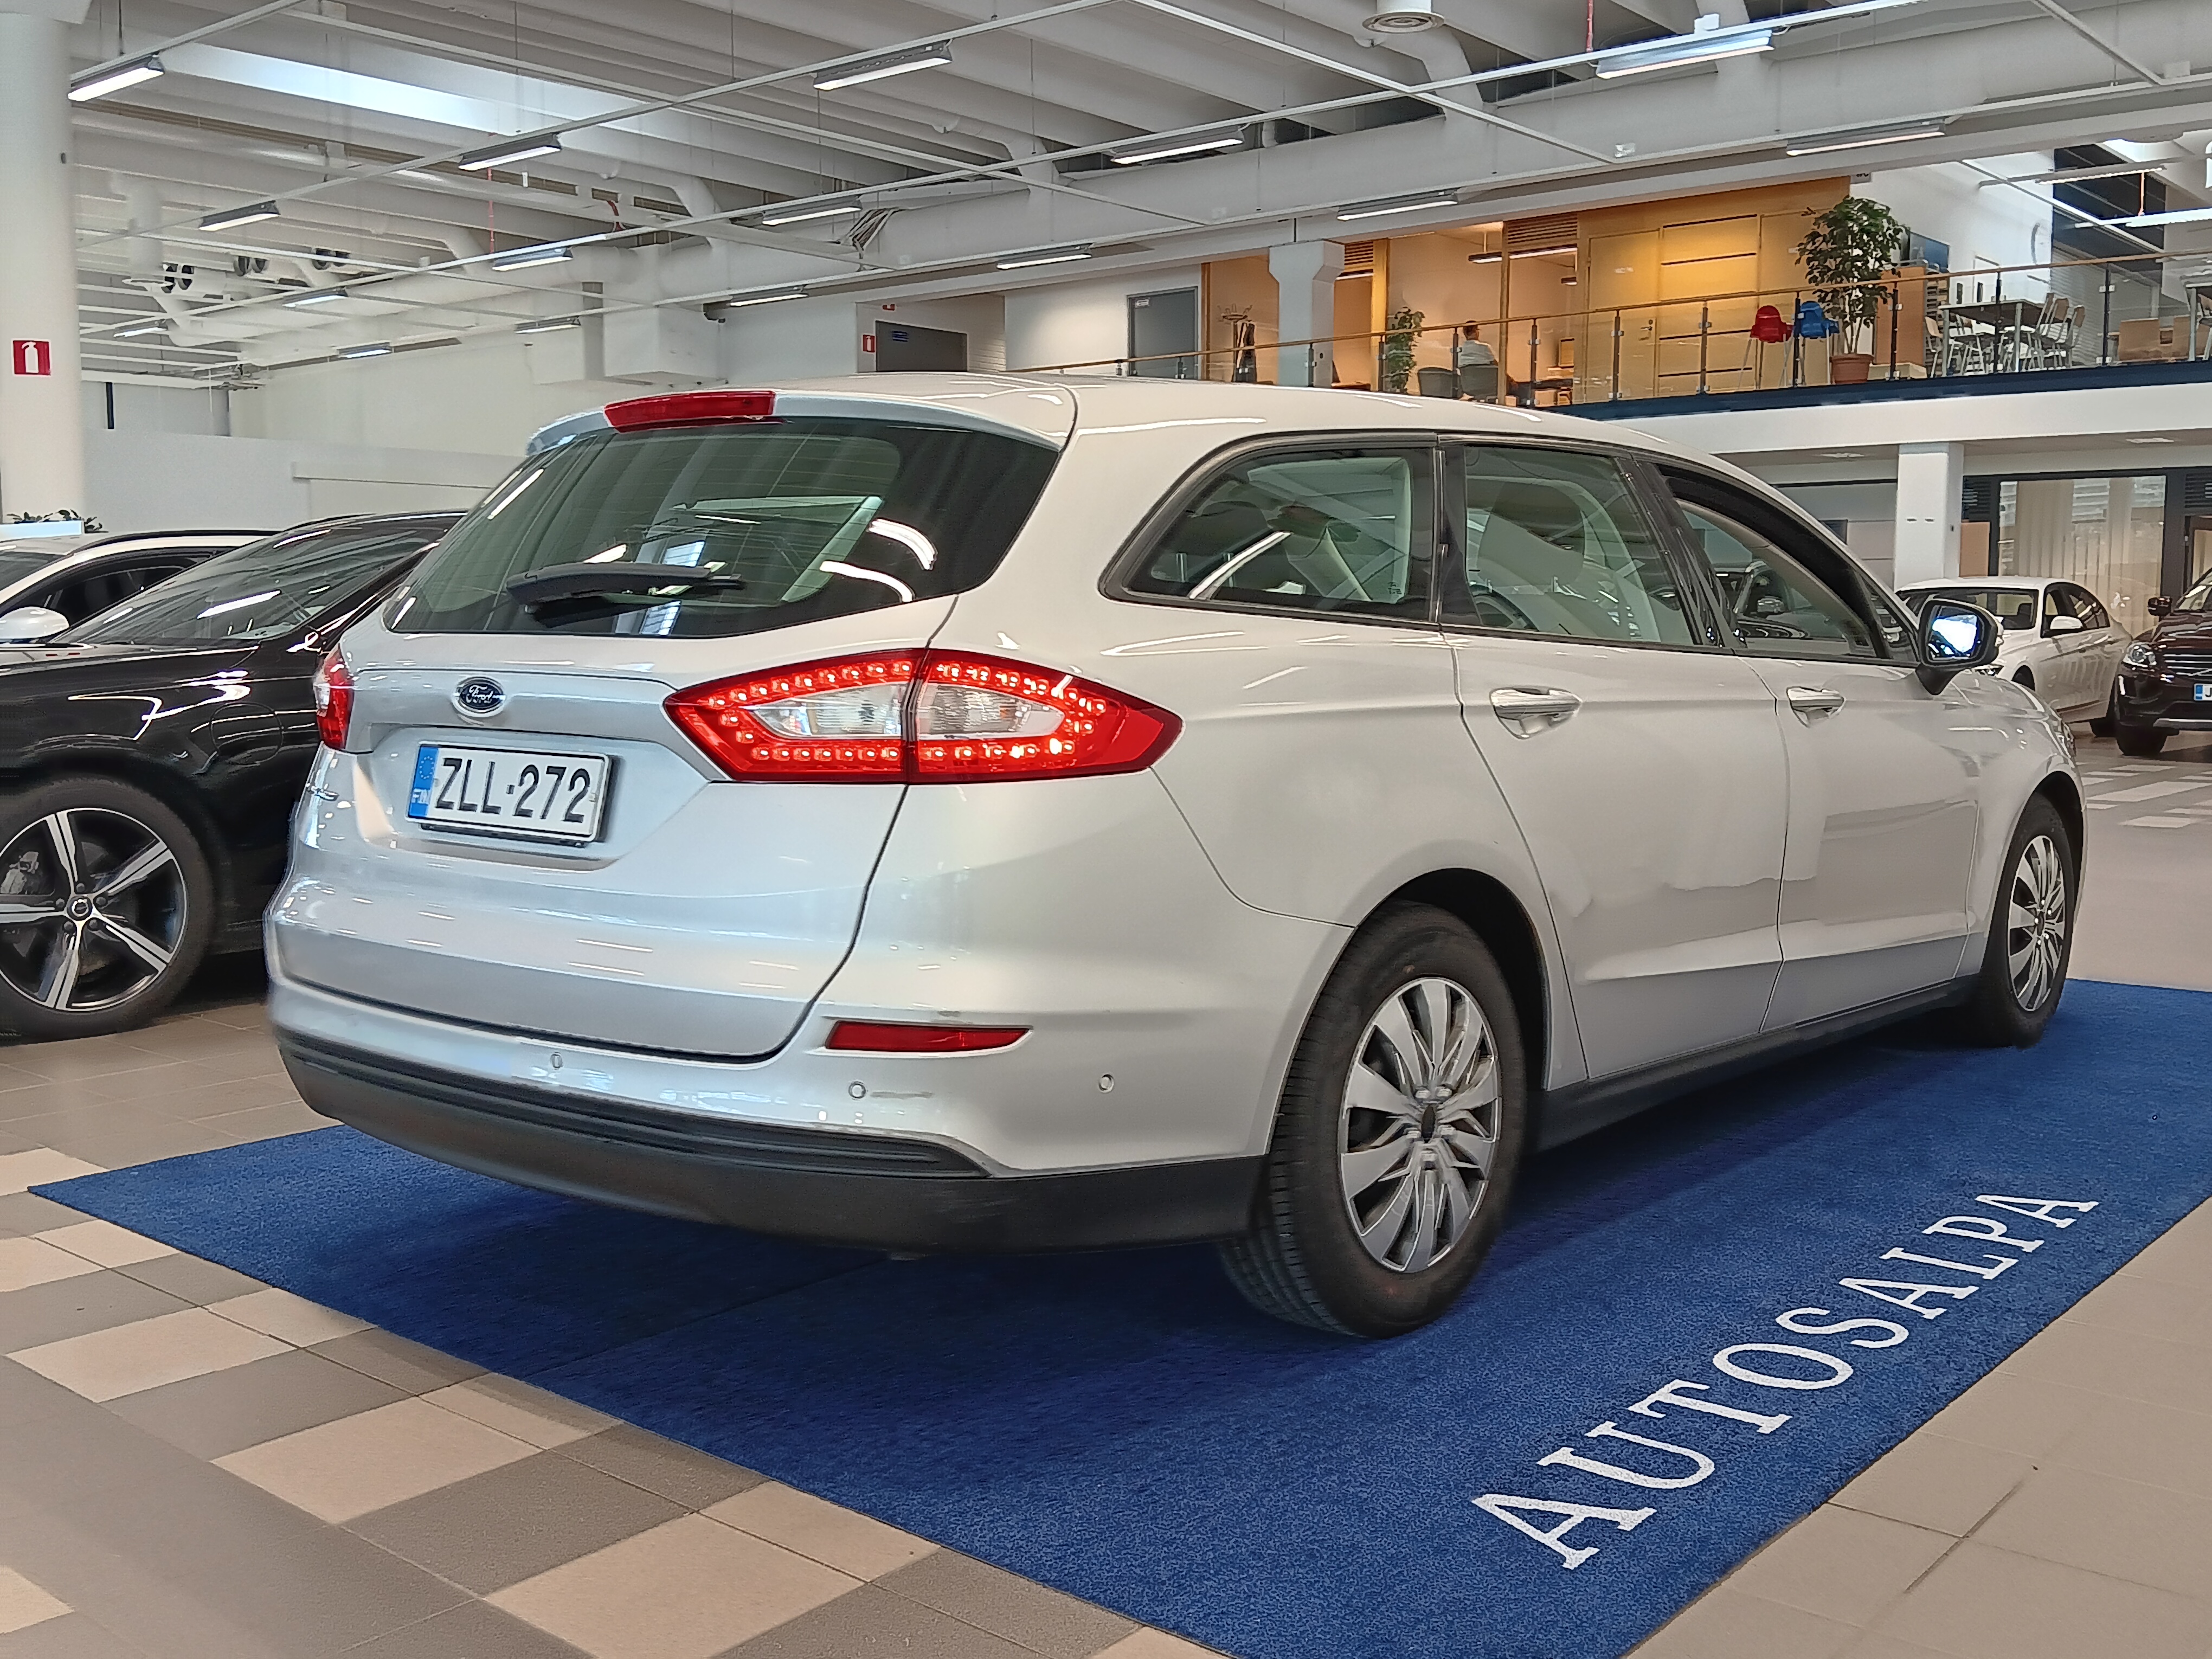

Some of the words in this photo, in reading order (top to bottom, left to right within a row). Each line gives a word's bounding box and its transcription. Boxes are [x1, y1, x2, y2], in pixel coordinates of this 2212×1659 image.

[466, 684, 496, 704] Ford
[434, 757, 590, 824] ZLL-272
[1471, 1194, 2099, 1571] AUTOSALPA
